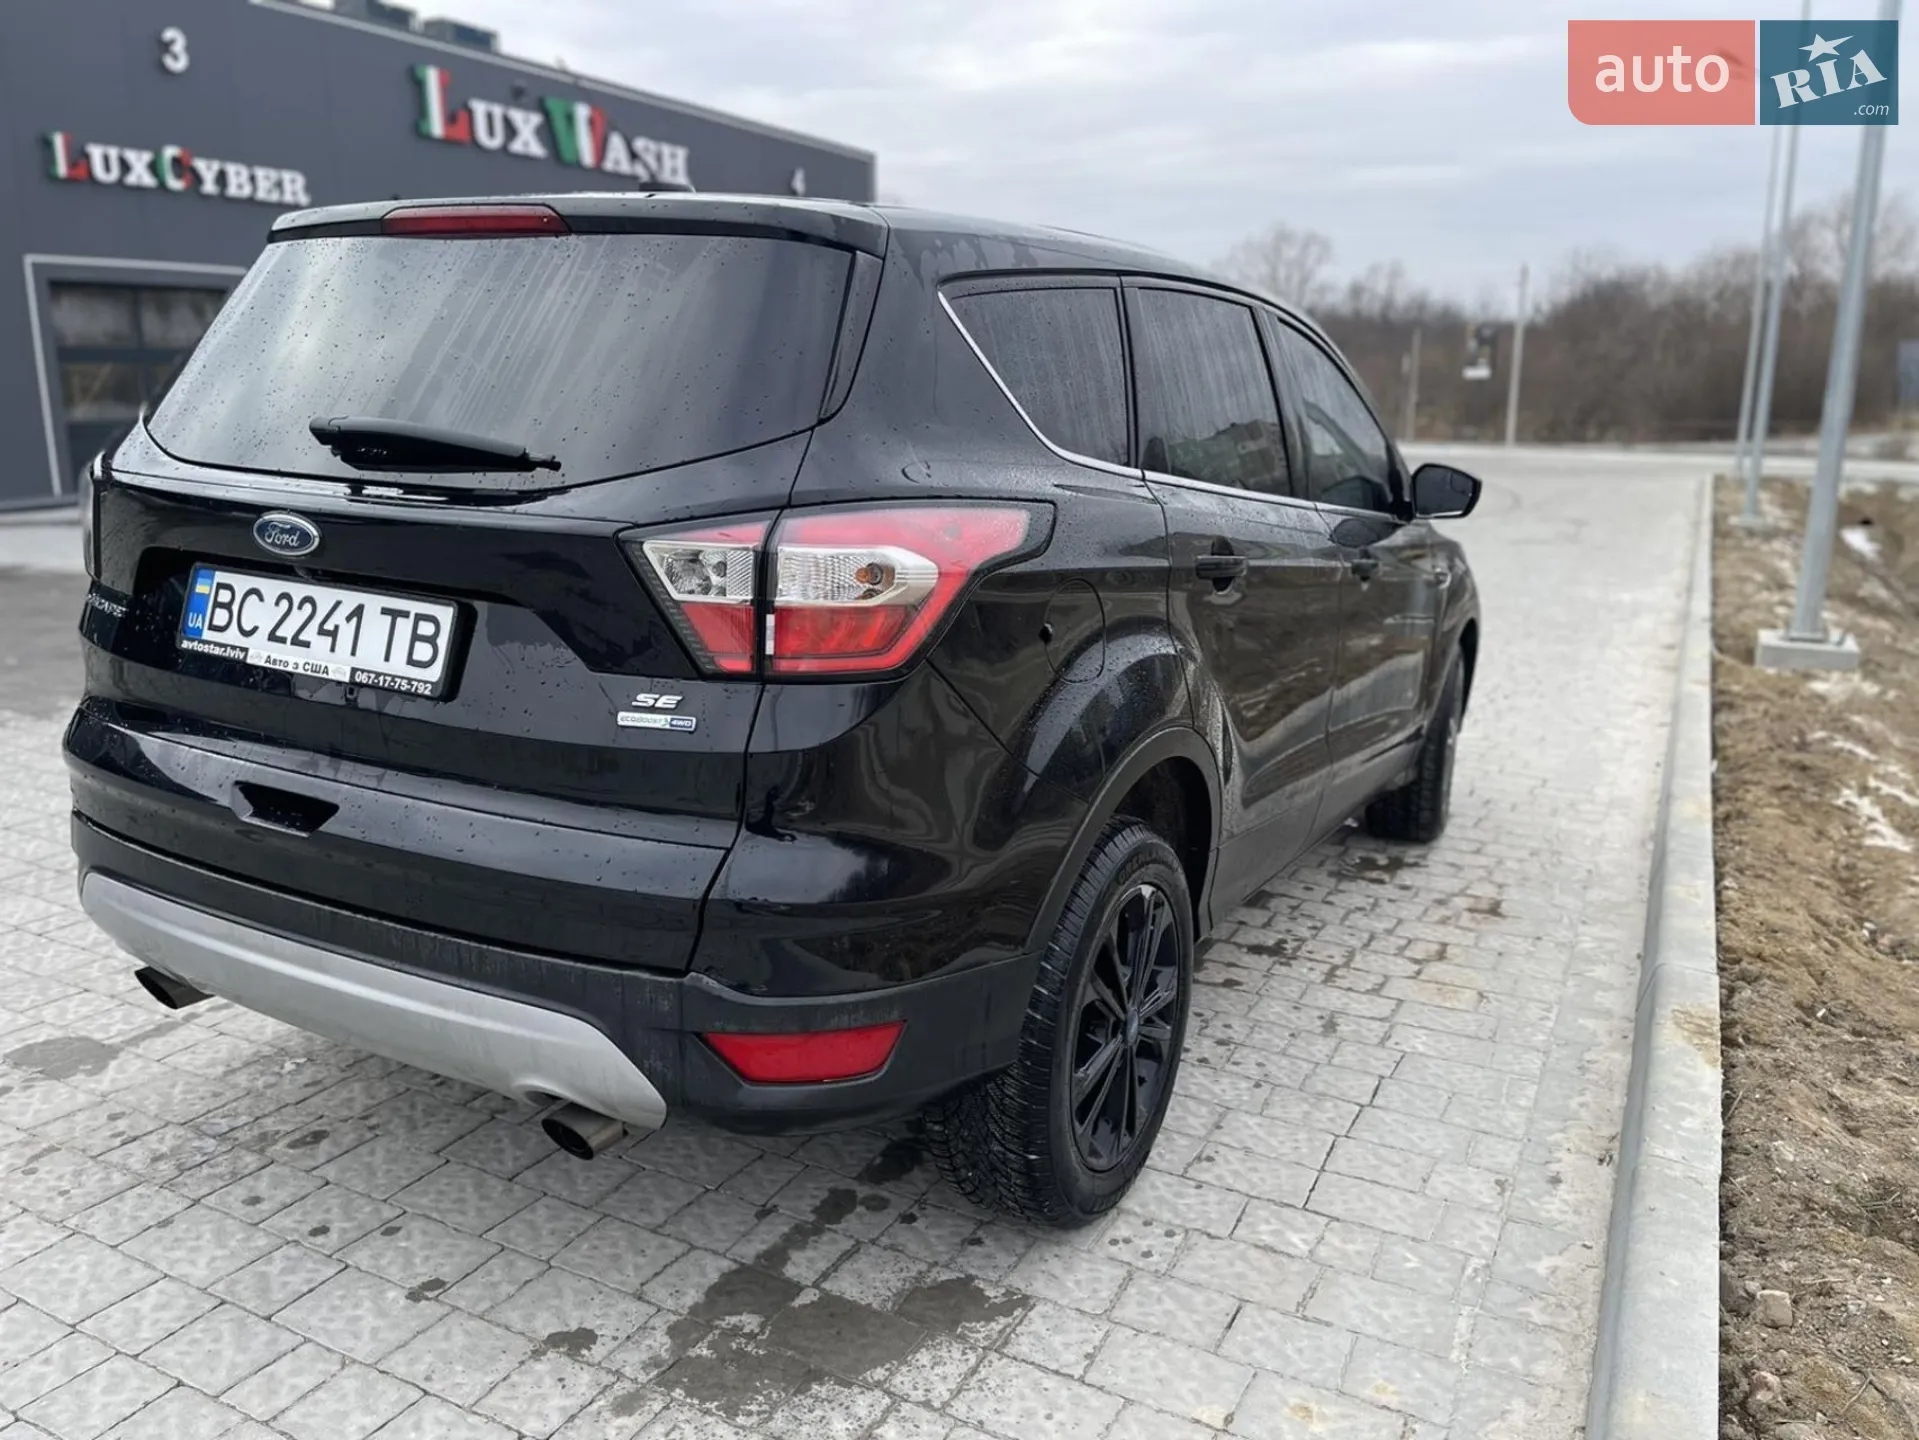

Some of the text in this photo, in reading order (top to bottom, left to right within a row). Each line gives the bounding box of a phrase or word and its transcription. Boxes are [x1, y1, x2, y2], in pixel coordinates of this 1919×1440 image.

[160, 26, 190, 74] 3
[46, 131, 311, 206] LUXCYBER
[264, 521, 301, 547] Ford
[187, 611, 203, 630] UA
[206, 581, 442, 670] BC 2241 TB
[180, 639, 247, 661] avtostar.lviv
[264, 654, 290, 669] Авто
[302, 661, 330, 677] США
[354, 670, 433, 696] 067-17-75-792
[631, 692, 684, 709] SE
